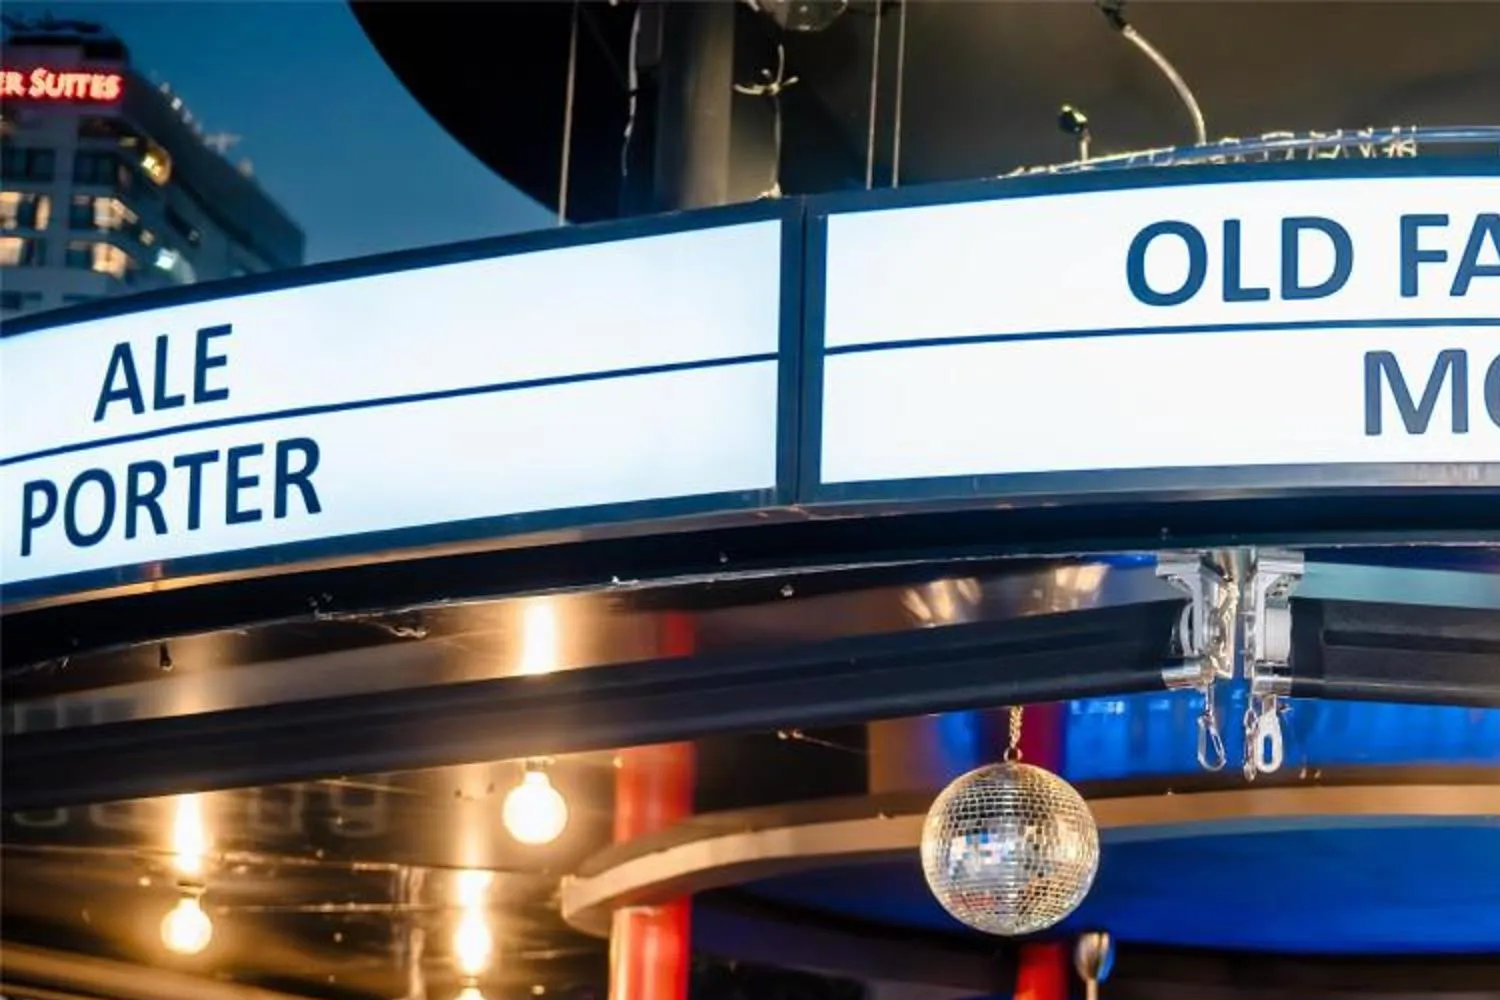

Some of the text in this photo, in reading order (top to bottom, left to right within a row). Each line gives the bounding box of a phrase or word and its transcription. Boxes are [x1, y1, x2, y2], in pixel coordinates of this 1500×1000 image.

[1125, 216, 1355, 306] OLD
[93, 324, 233, 422] ALE
[20, 437, 322, 556] PORTER
